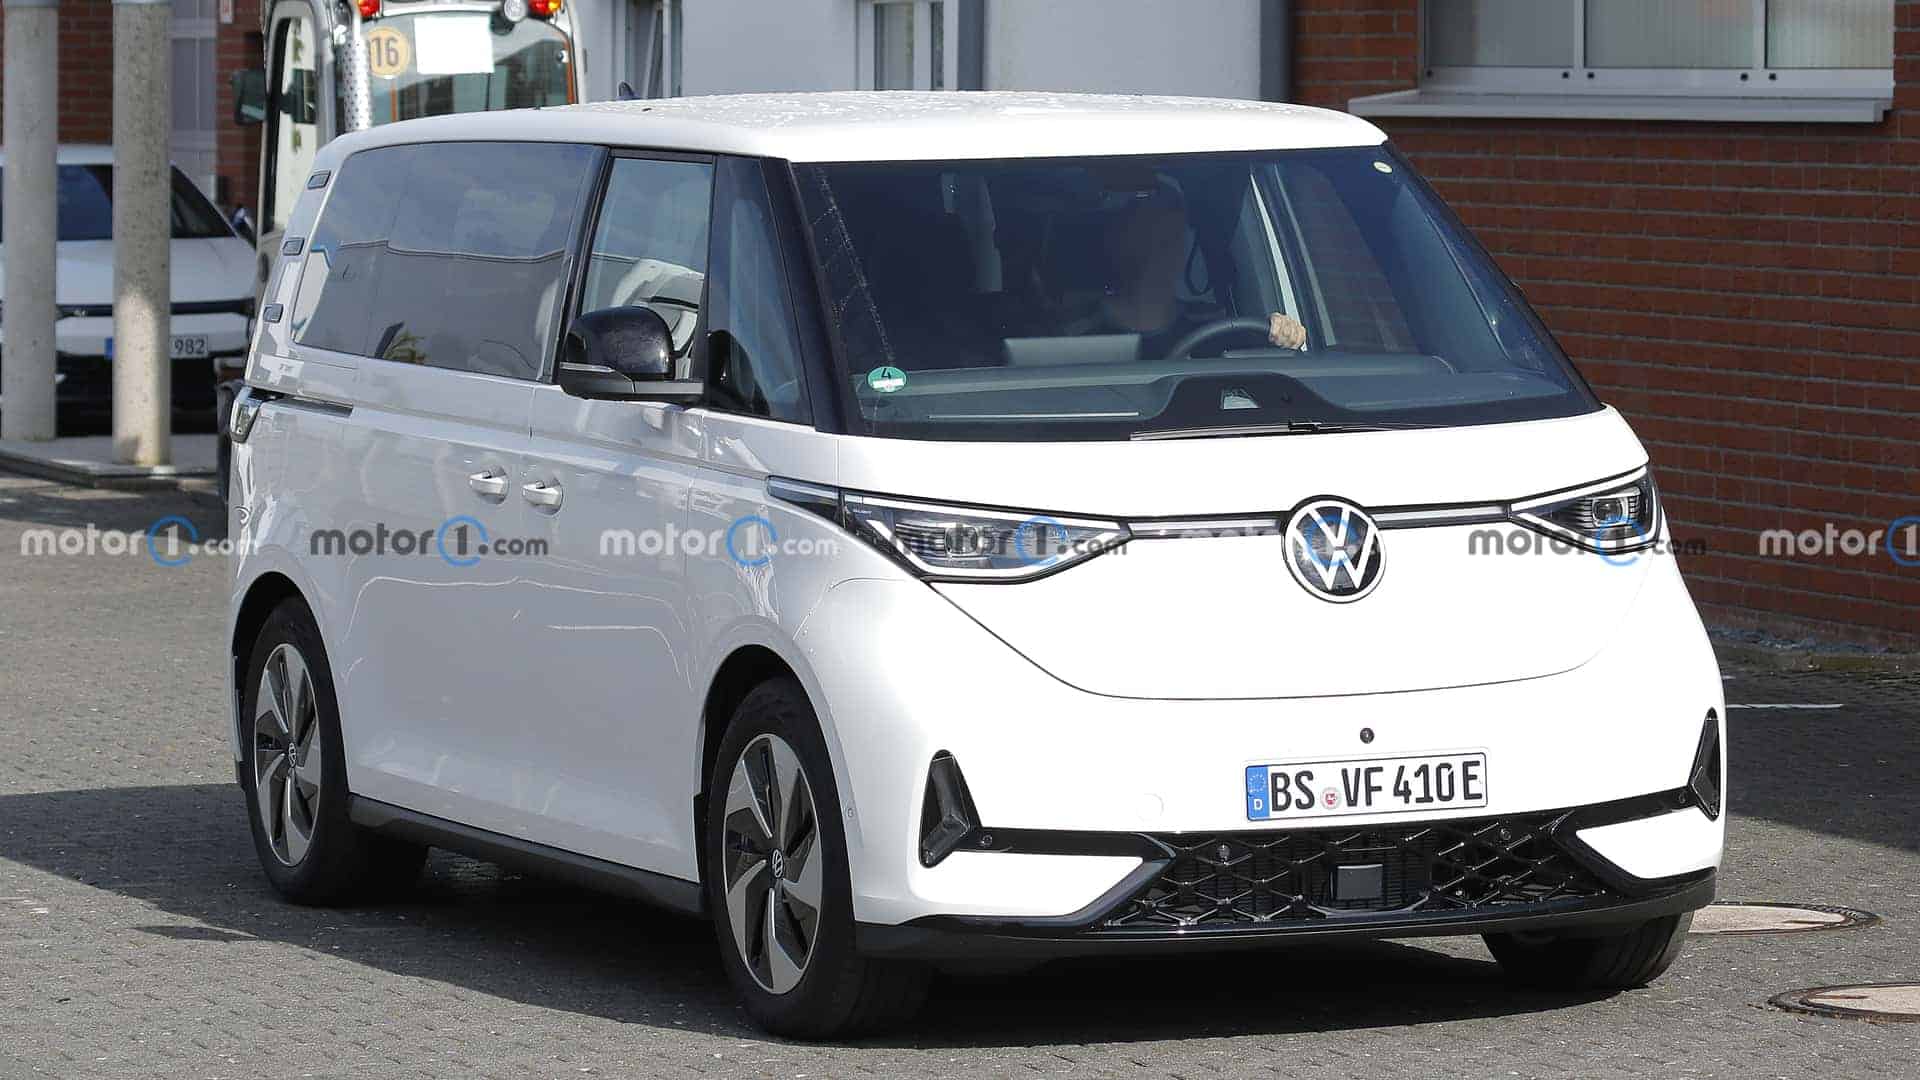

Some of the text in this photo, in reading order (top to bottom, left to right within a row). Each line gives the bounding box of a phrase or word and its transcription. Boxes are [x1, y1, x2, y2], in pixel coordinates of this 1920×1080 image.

[370, 37, 399, 67] 16
[174, 338, 205, 354] 982
[880, 367, 892, 379] 4
[1292, 505, 1379, 590] VW
[1271, 770, 1315, 812] BS
[1341, 766, 1384, 807] VF
[1253, 799, 1263, 810] D
